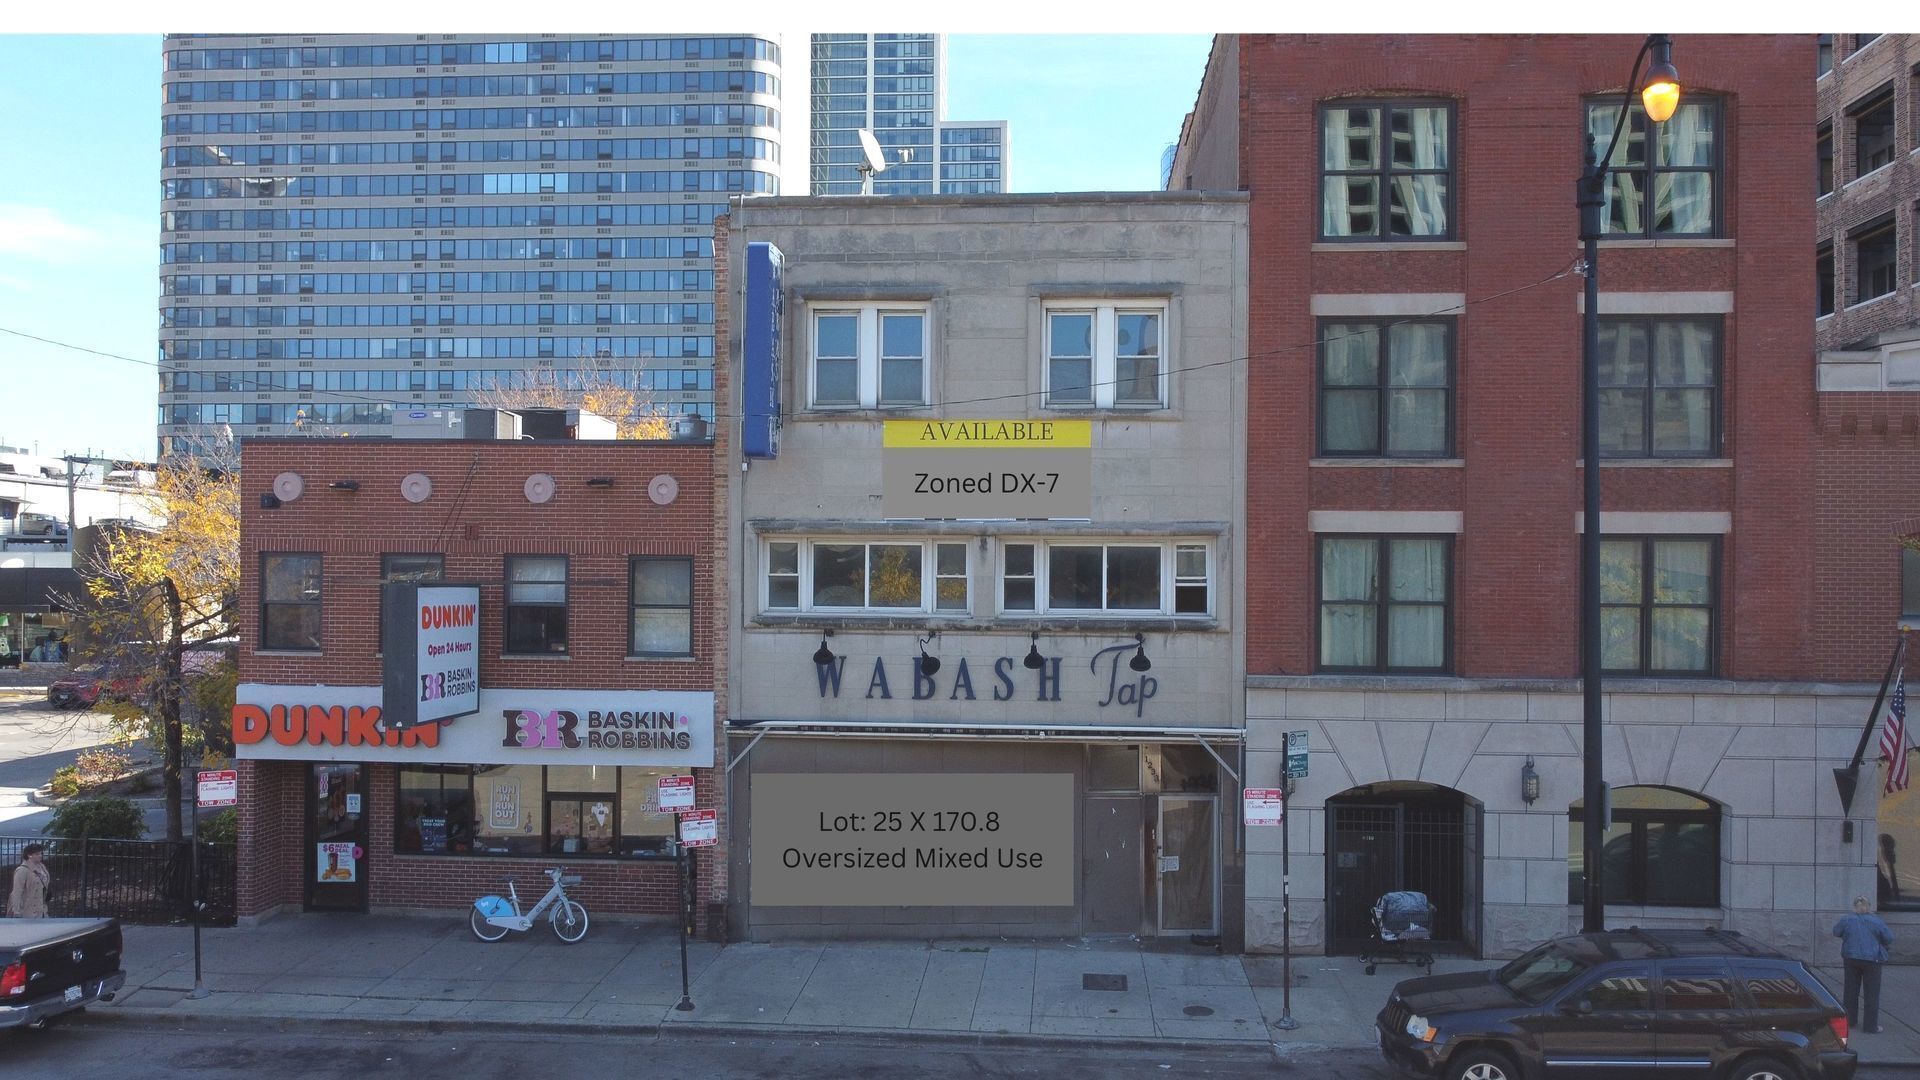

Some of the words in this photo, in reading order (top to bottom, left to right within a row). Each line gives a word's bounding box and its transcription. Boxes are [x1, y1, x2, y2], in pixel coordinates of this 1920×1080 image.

[920, 422, 1054, 441] AVAILABLE
[421, 604, 476, 630] DUNKIN'
[428, 644, 445, 658] Open
[446, 642, 454, 654] 24
[455, 641, 472, 653] Hours
[447, 667, 472, 683] BASKIN
[814, 656, 1063, 701] WABASH
[1090, 643, 1159, 718] Tap
[447, 680, 476, 698] ROBBINS
[588, 711, 675, 730] BASKIN
[588, 731, 691, 750] ROBBINS
[496, 785, 516, 794] RUN
[500, 794, 511, 802] IN
[495, 802, 515, 810] RUN
[495, 810, 516, 818] OUT
[323, 844, 335, 853] $6
